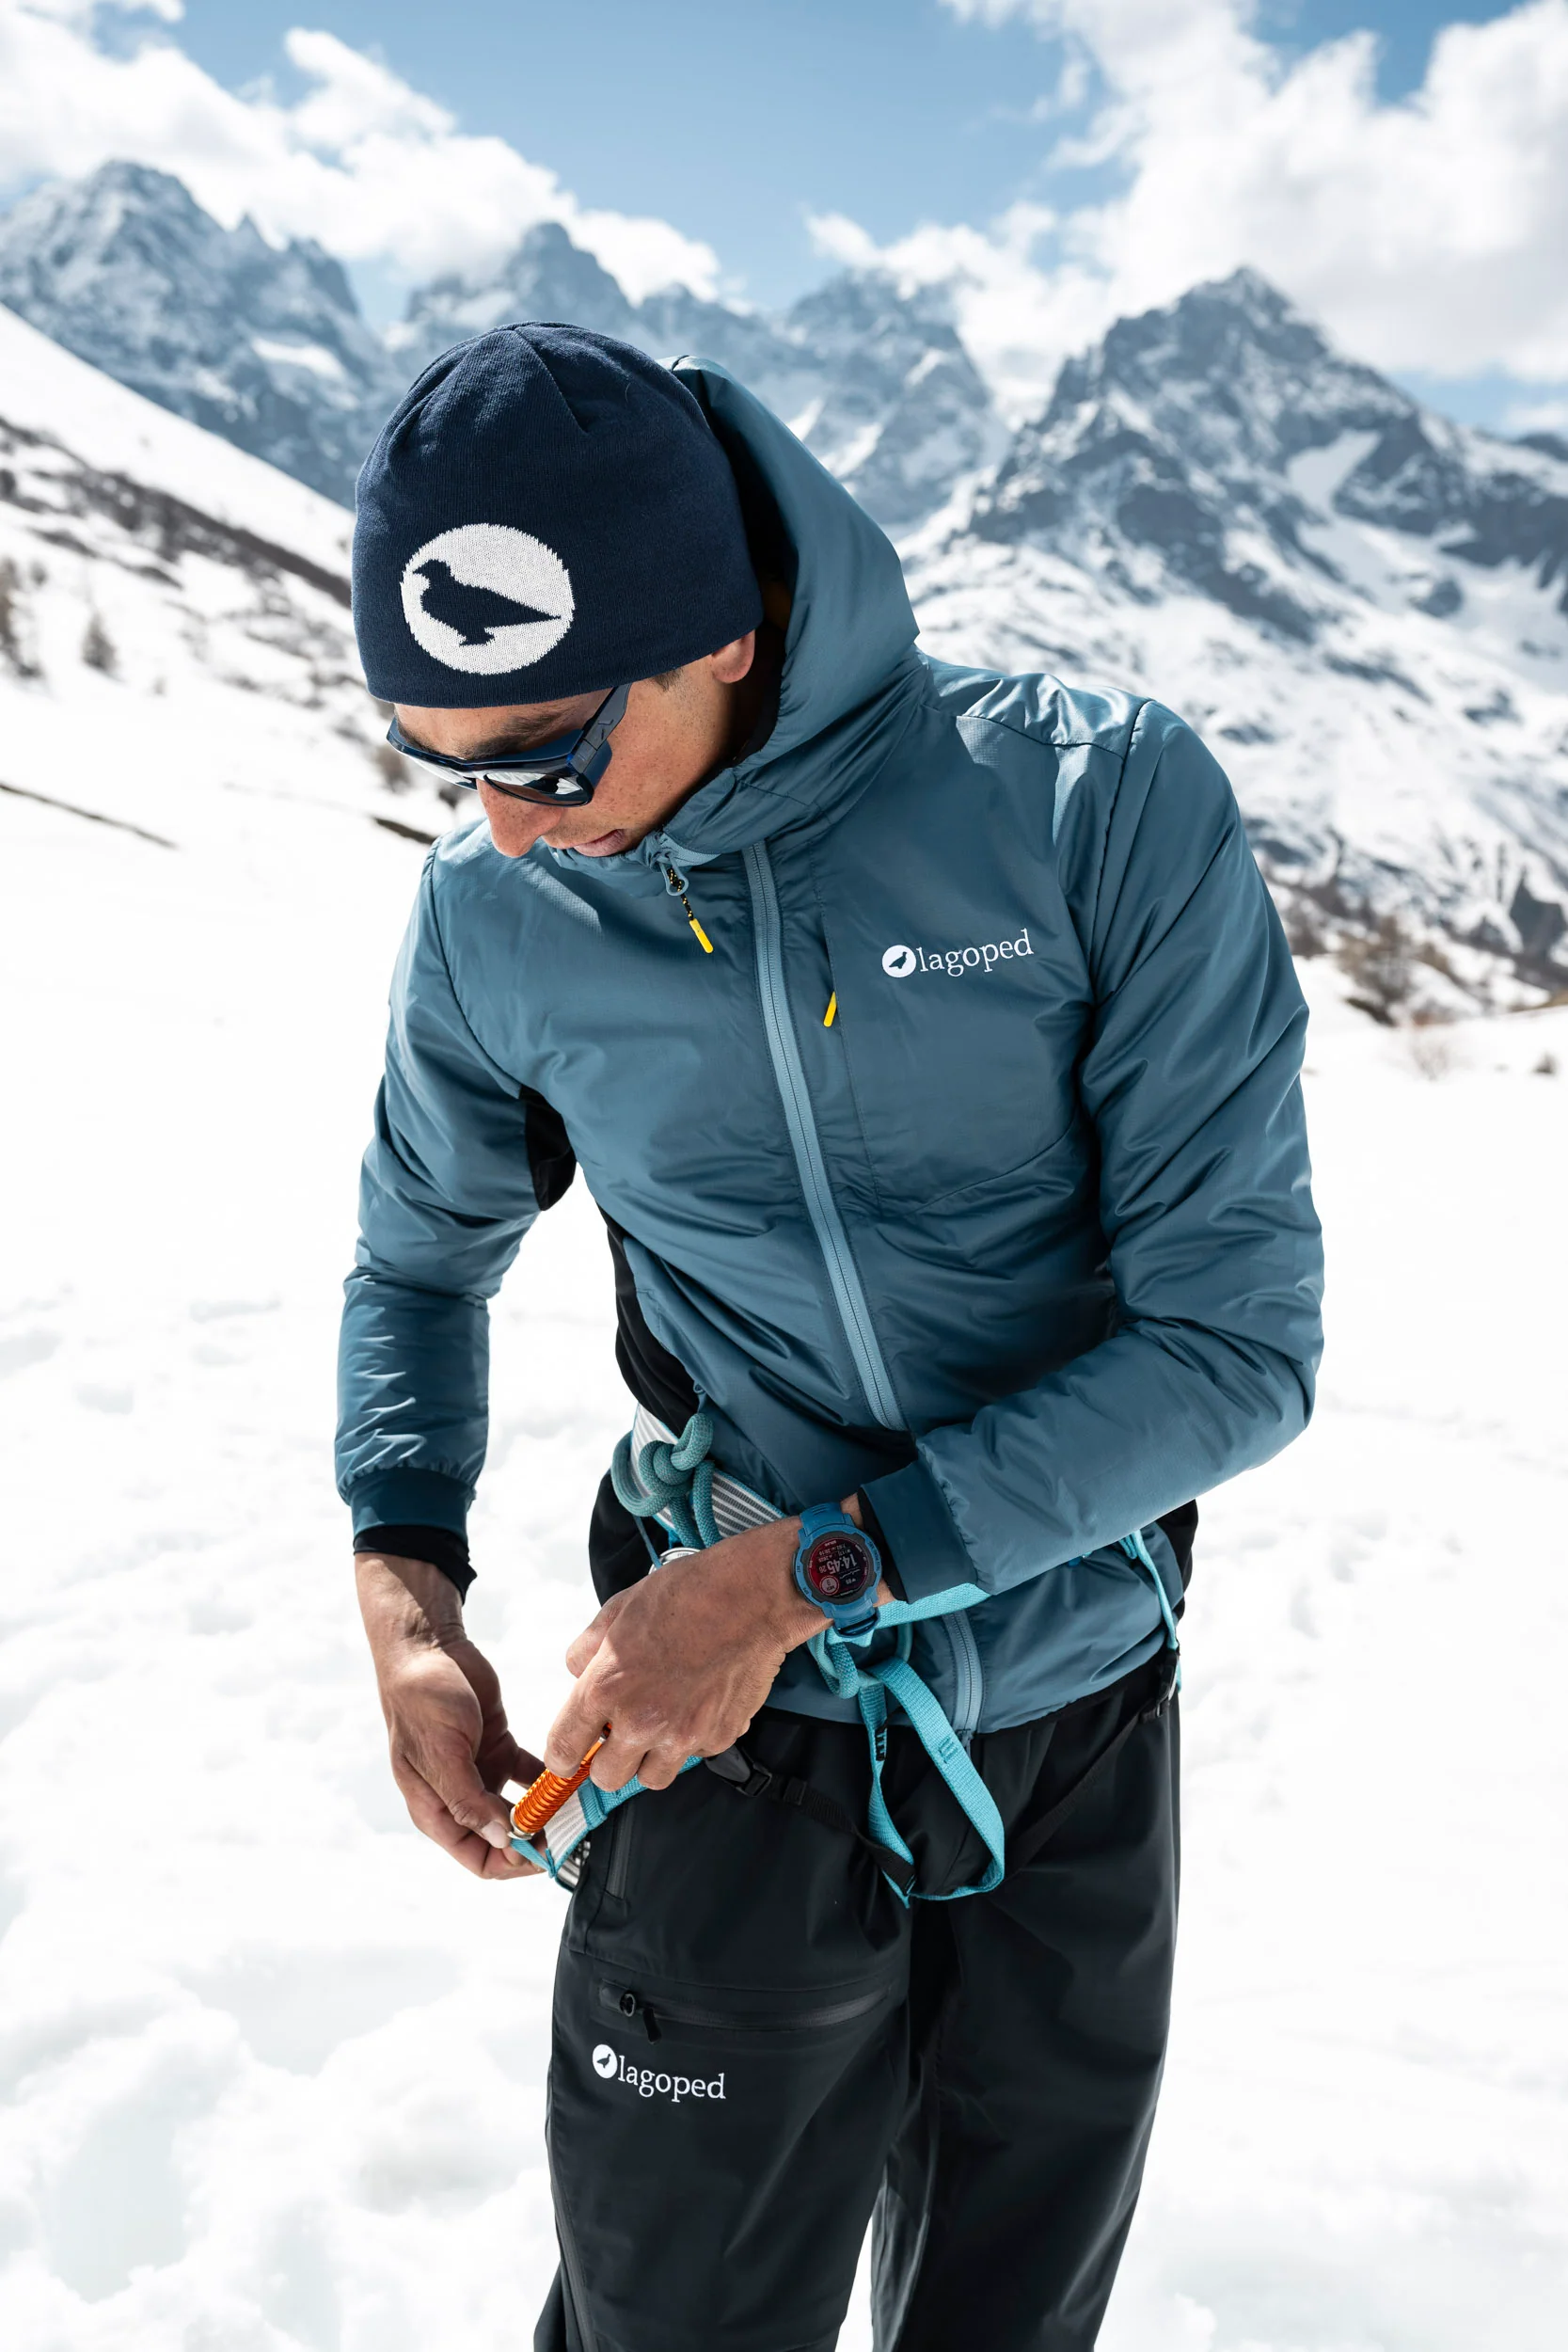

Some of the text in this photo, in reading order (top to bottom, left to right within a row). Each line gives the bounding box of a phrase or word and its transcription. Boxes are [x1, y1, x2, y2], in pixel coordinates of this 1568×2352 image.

[916, 928, 1035, 977] lagoped
[826, 1553, 857, 1575] 14:45
[617, 2055, 726, 2103] lagoped
